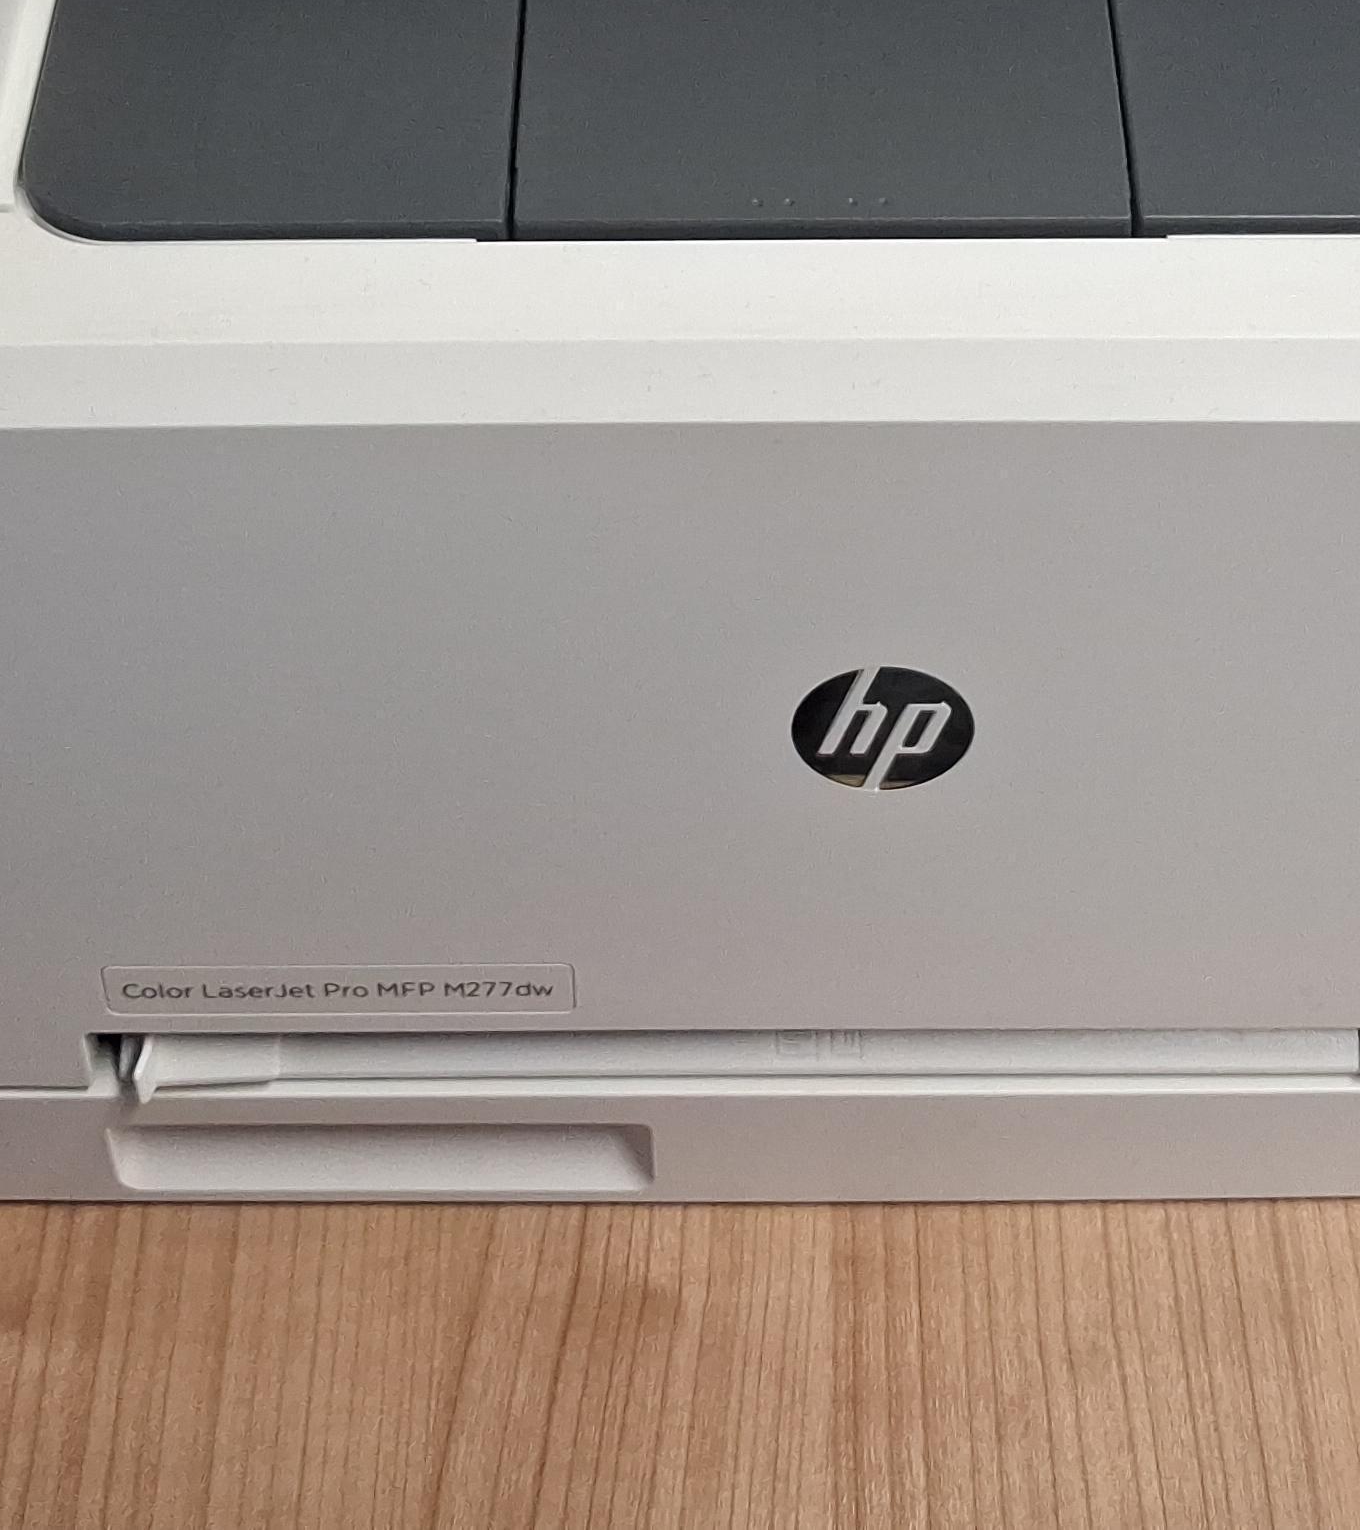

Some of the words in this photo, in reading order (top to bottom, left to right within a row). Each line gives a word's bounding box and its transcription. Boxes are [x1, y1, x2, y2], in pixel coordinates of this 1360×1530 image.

[816, 666, 952, 790] hp
[122, 982, 192, 1000] Color
[202, 982, 316, 1000] LaserJet
[324, 982, 369, 999] Pro
[377, 982, 436, 999] MFP
[444, 981, 555, 998] M277dw
